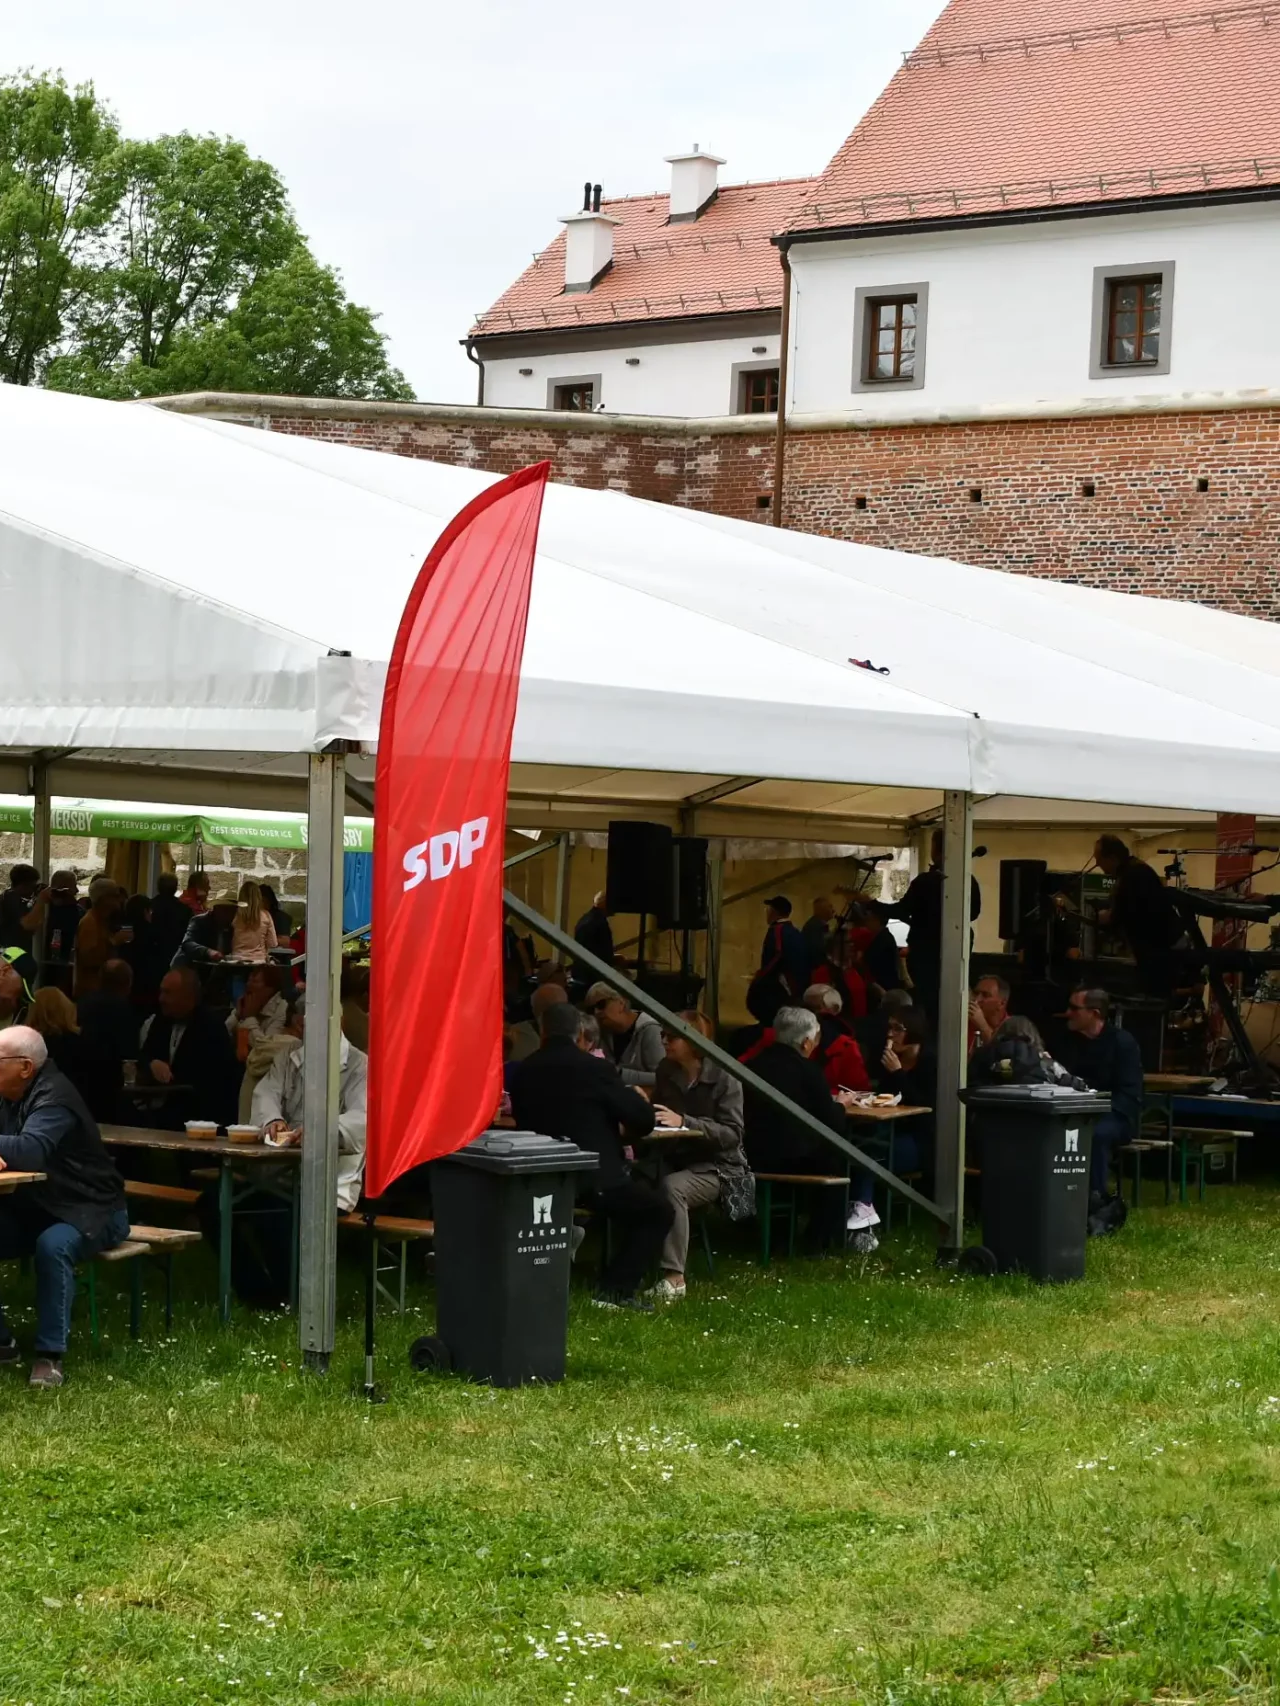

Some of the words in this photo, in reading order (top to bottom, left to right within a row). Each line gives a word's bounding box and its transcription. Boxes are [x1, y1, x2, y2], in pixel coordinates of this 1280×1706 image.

[9, 813, 21, 823] ICE
[102, 819, 119, 828] BEST
[121, 820, 150, 830] SERVED
[151, 822, 171, 831] OVER
[173, 824, 187, 833] ICE
[210, 825, 228, 835] BEST
[230, 826, 258, 836] SERVED
[260, 829, 279, 838] OVER
[280, 830, 292, 838] ICE
[403, 816, 488, 892] SDP
